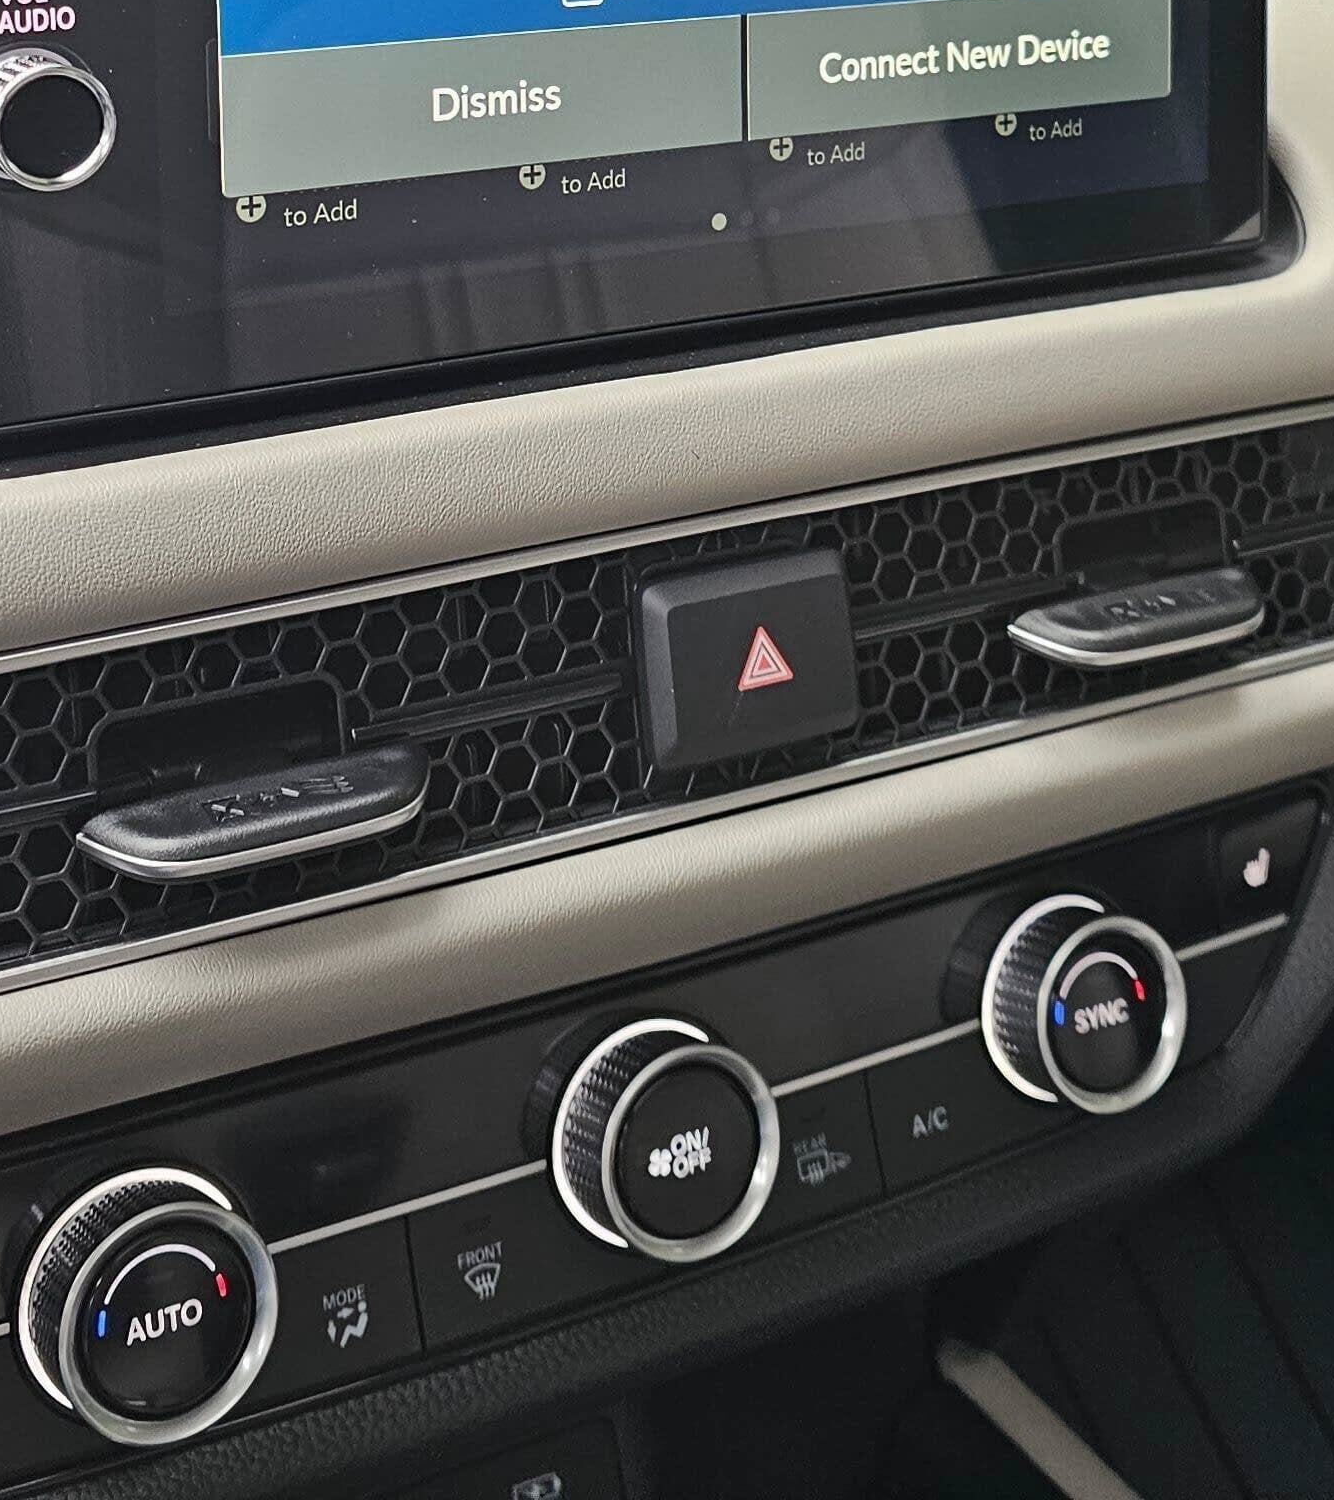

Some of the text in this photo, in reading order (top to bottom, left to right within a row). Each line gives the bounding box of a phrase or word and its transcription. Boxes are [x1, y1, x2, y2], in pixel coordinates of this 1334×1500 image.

[819, 29, 1111, 84] Connect New Device
[431, 79, 562, 122] Dismiss
[1028, 117, 1083, 142] to Add
[806, 140, 866, 166] to Add
[561, 168, 627, 195] to Add
[283, 198, 358, 228] to Add
[1074, 997, 1130, 1035] SYNC
[911, 1105, 949, 1139] A/C
[670, 1125, 711, 1157] ON/
[671, 1145, 712, 1180] OFF
[456, 1240, 503, 1270] FRONT
[322, 1283, 366, 1311] MODE
[126, 1298, 203, 1347] AUTO
